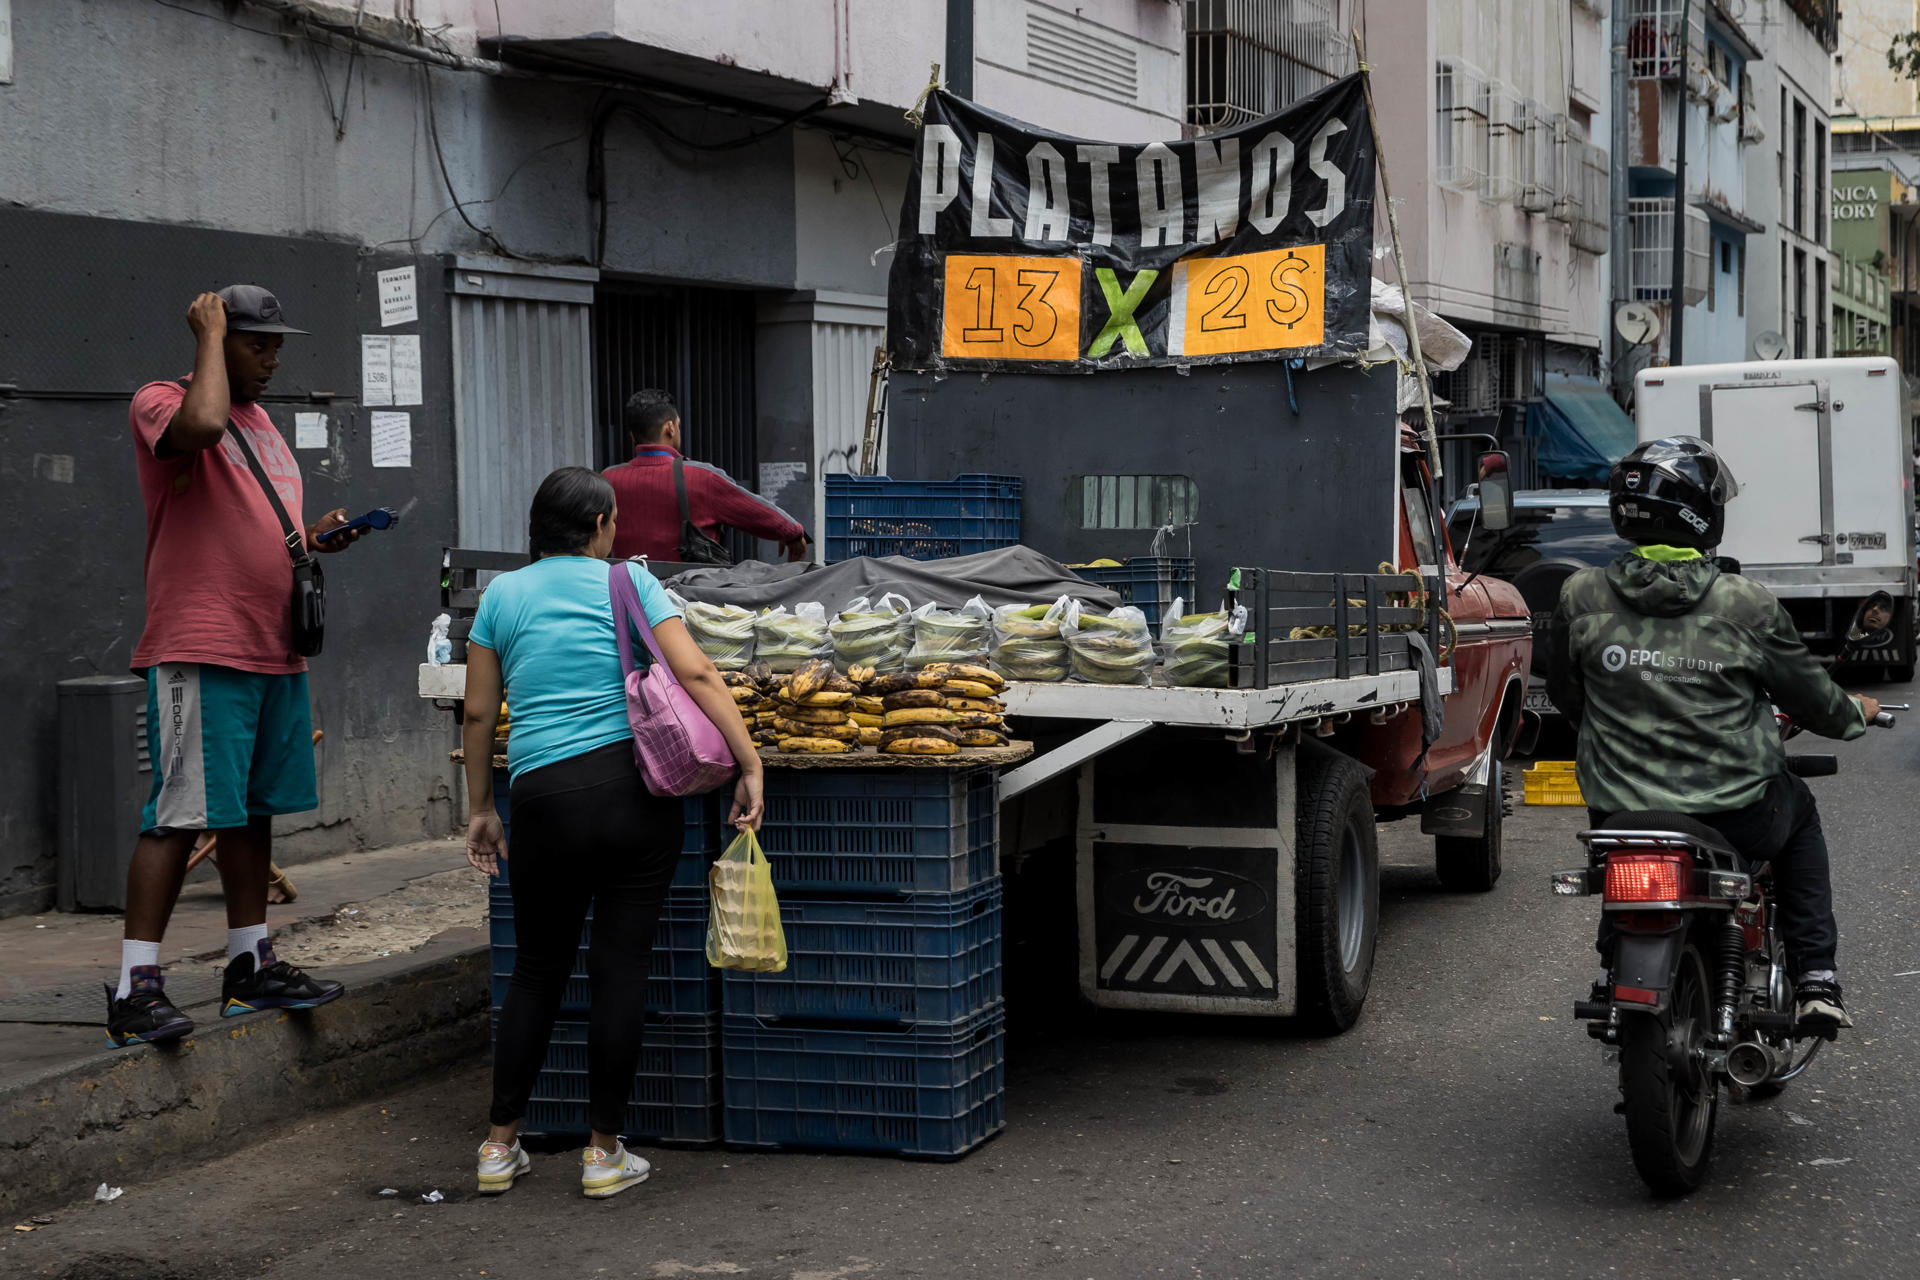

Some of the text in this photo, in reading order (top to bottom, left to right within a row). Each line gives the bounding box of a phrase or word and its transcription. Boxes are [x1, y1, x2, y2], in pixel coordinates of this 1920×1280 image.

[918, 117, 1348, 248] PLATANOS
[962, 267, 1060, 348] 13
[1088, 267, 1160, 358] X
[1678, 507, 1710, 535] EDGE
[1629, 649, 1723, 673] EPC STUDIO
[1655, 672, 1702, 685] @epcstudio
[1133, 872, 1237, 920] Ford
